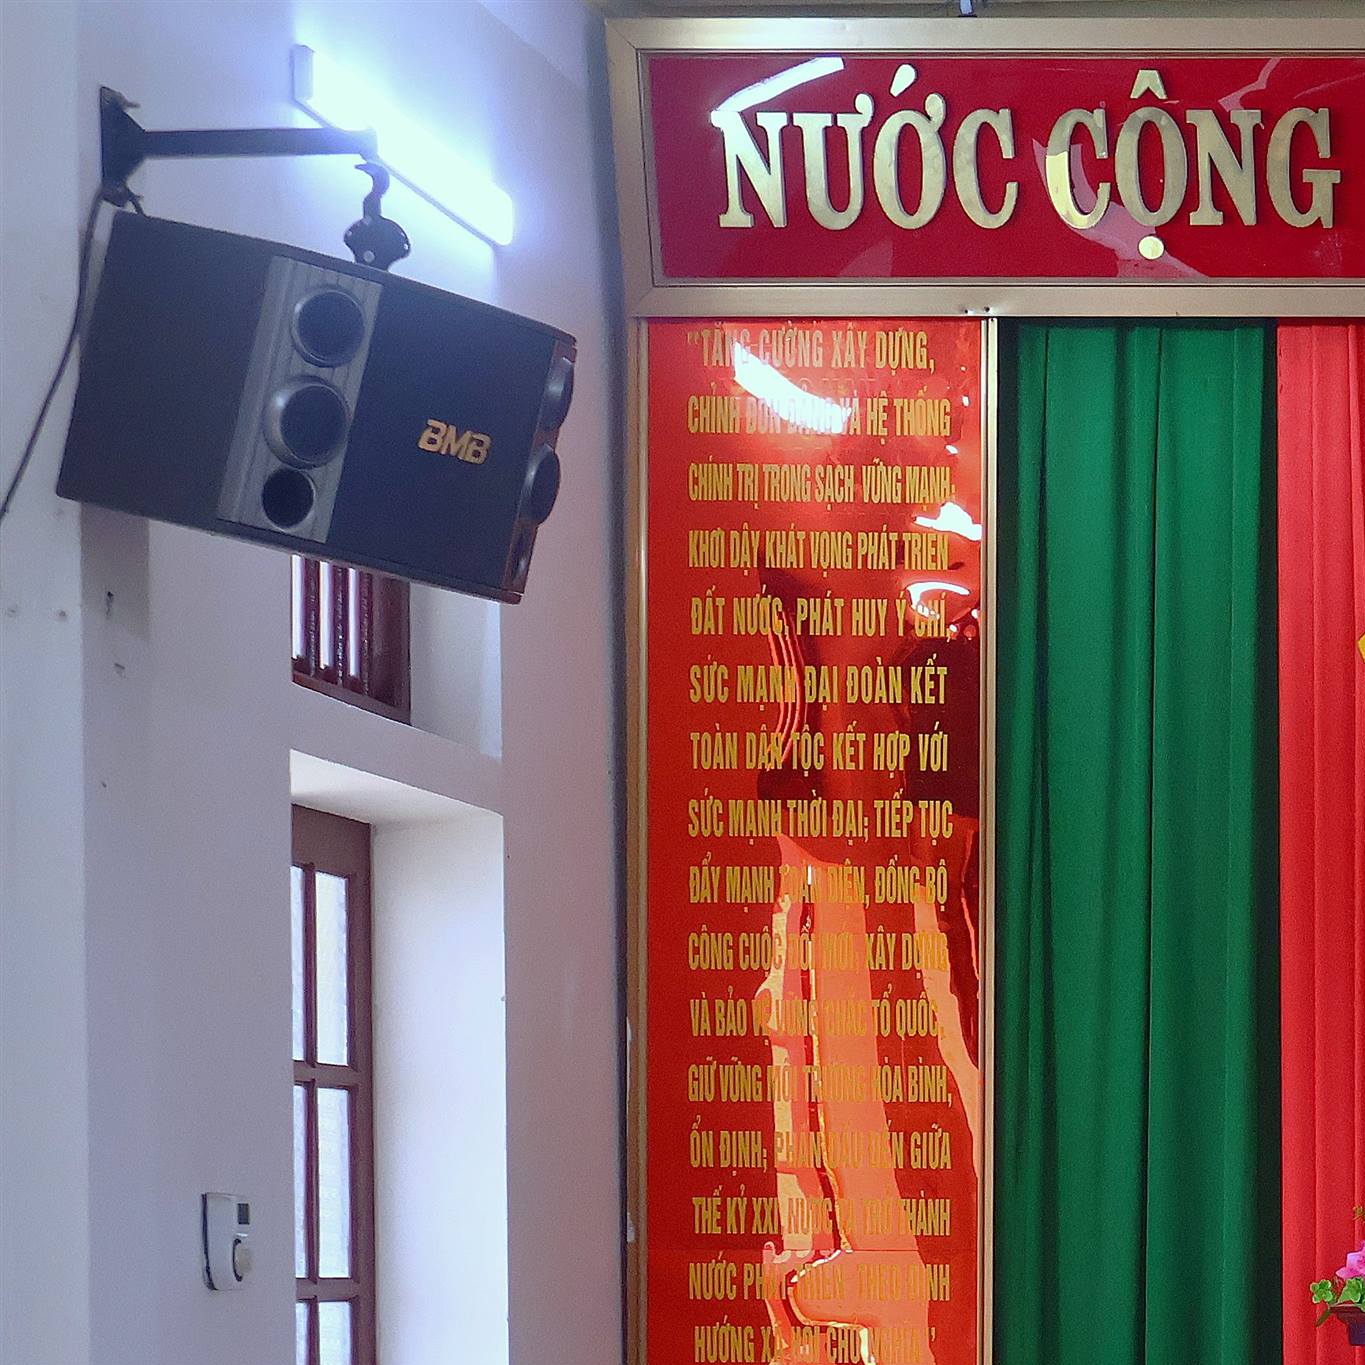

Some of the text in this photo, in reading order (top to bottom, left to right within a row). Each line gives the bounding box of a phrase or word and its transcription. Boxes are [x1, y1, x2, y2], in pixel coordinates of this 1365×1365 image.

[715, 62, 1019, 230] NƯỚC
[1044, 69, 1341, 260] CỘNG
[416, 419, 493, 466] BMB
[763, 463, 812, 502] TRONG
[856, 524, 899, 570] PHÁT
[796, 590, 845, 636] PHÁT
[851, 598, 889, 637] HUY
[689, 654, 729, 703] SỨC
[804, 665, 839, 711] ĐẠI
[846, 656, 902, 704] ĐOÀN
[910, 653, 948, 705] KẾT
[690, 722, 738, 770] TOÀN
[791, 723, 825, 777] TỘC
[832, 720, 867, 771] KẾT
[918, 721, 949, 772] VỚI
[687, 787, 725, 838] SỨC
[873, 787, 914, 838] TIẾP
[918, 800, 953, 847] TỤC
[687, 924, 734, 971] CÔNG
